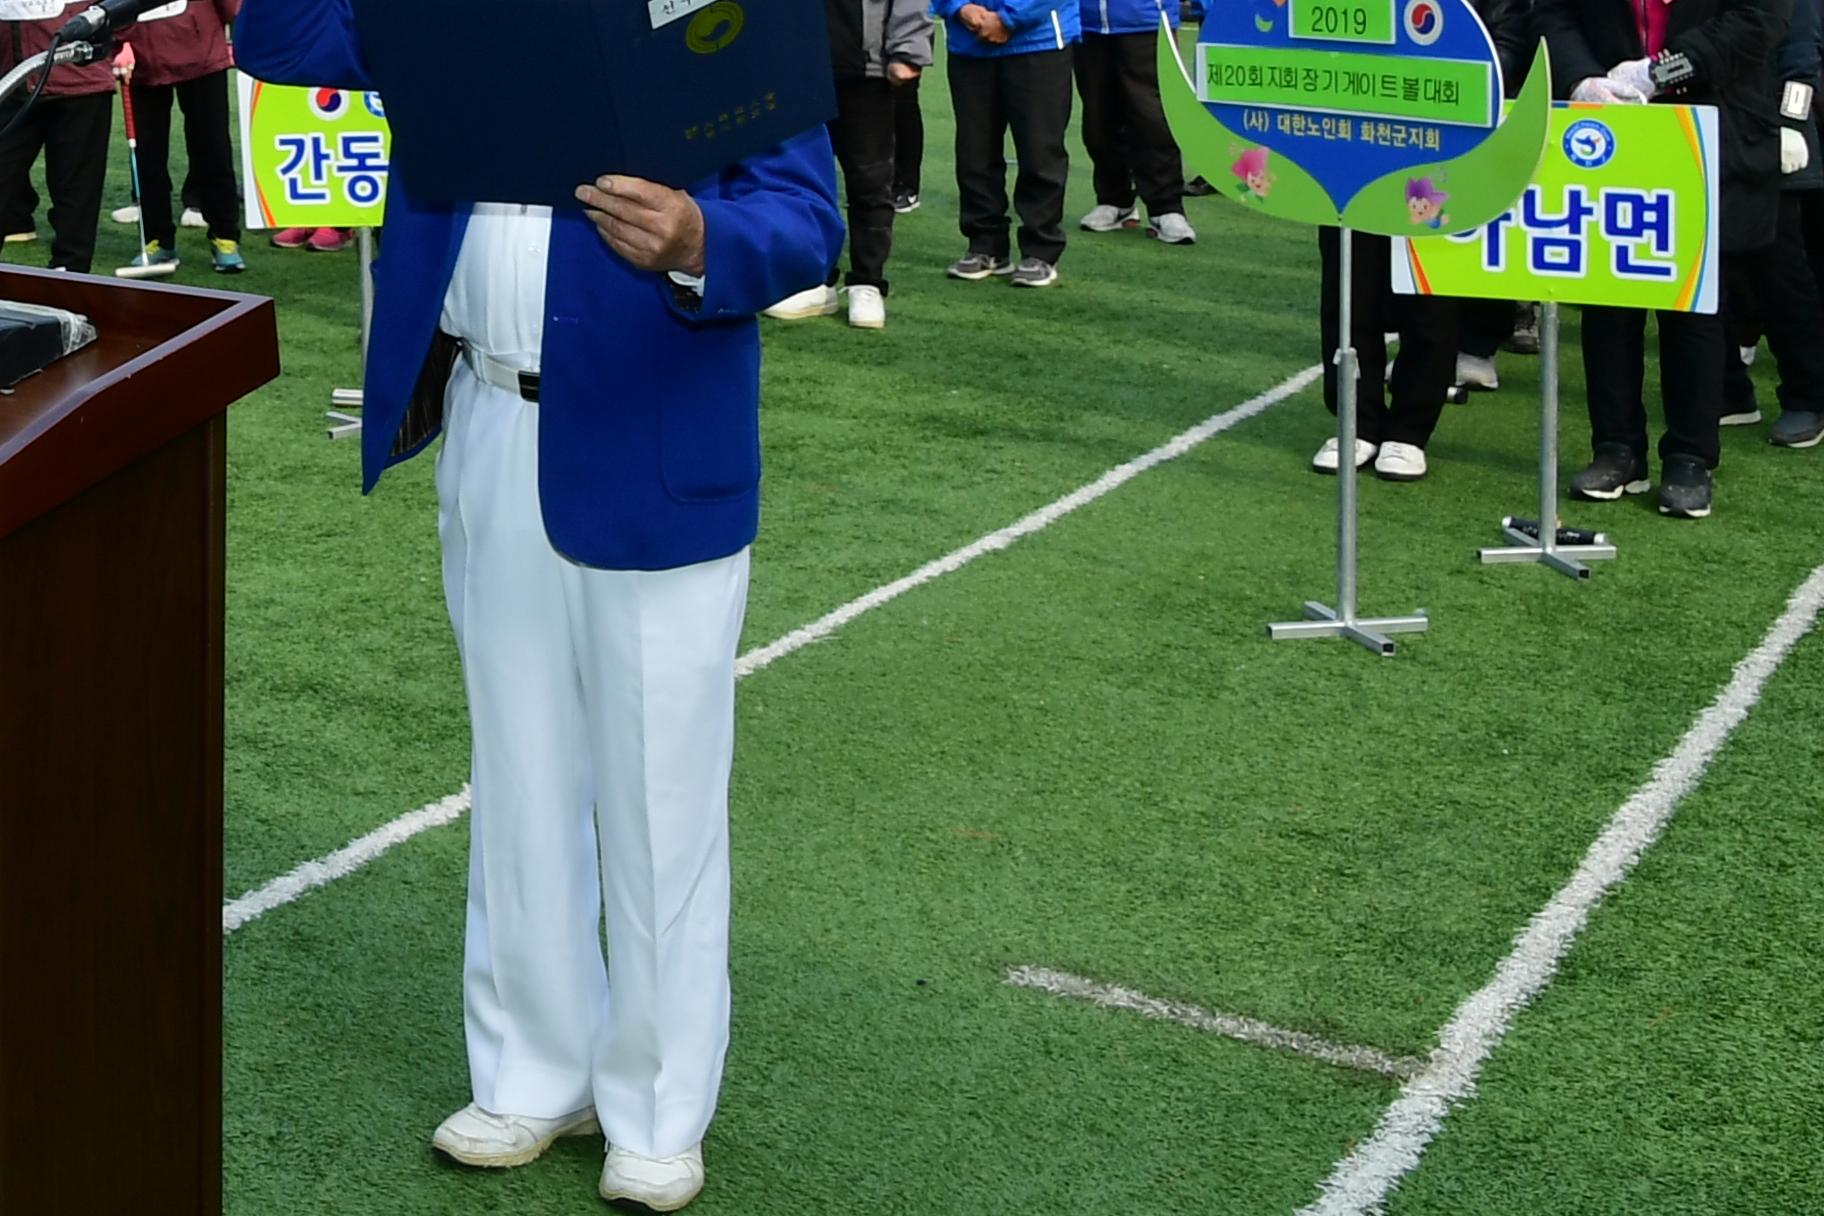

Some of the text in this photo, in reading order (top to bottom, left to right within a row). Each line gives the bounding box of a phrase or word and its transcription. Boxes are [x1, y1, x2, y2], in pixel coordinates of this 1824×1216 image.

[1310, 5, 1368, 35] 2019
[1242, 109, 1441, 151] (사) 대한노인회 화천군지회
